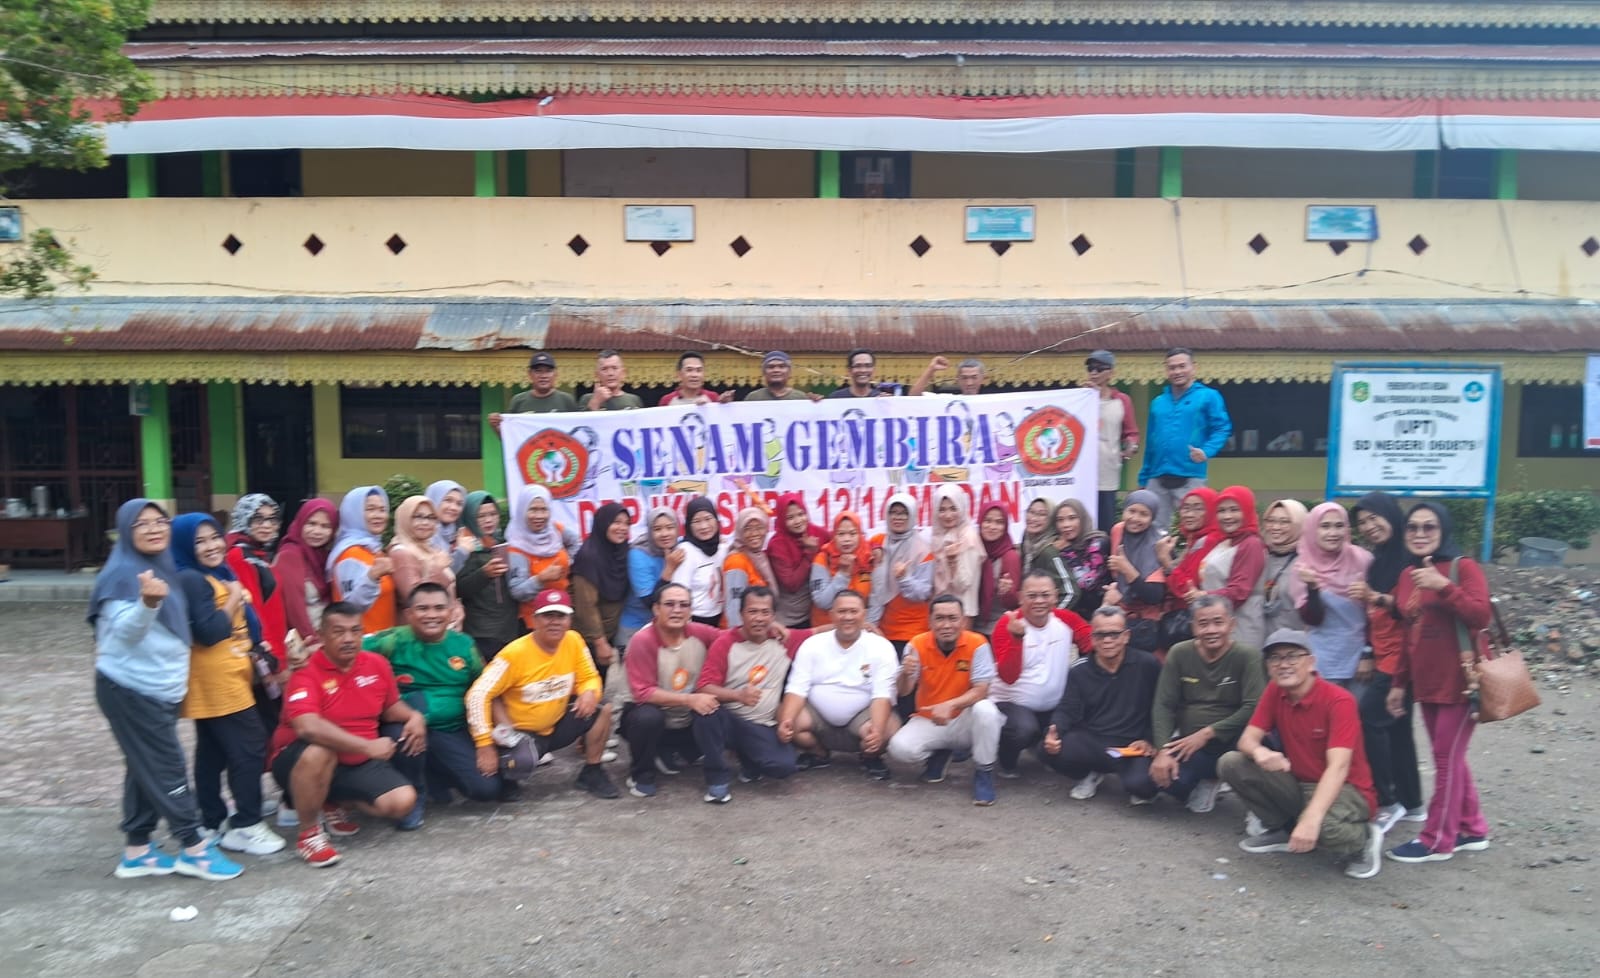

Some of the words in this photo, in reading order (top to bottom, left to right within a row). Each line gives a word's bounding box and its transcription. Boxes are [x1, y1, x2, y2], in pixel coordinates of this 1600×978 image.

[611, 423, 765, 480] SENAM
[785, 414, 996, 472] GEMBIRA
[1374, 439, 1424, 450] NEGERI
[907, 480, 1021, 529] MDAN
